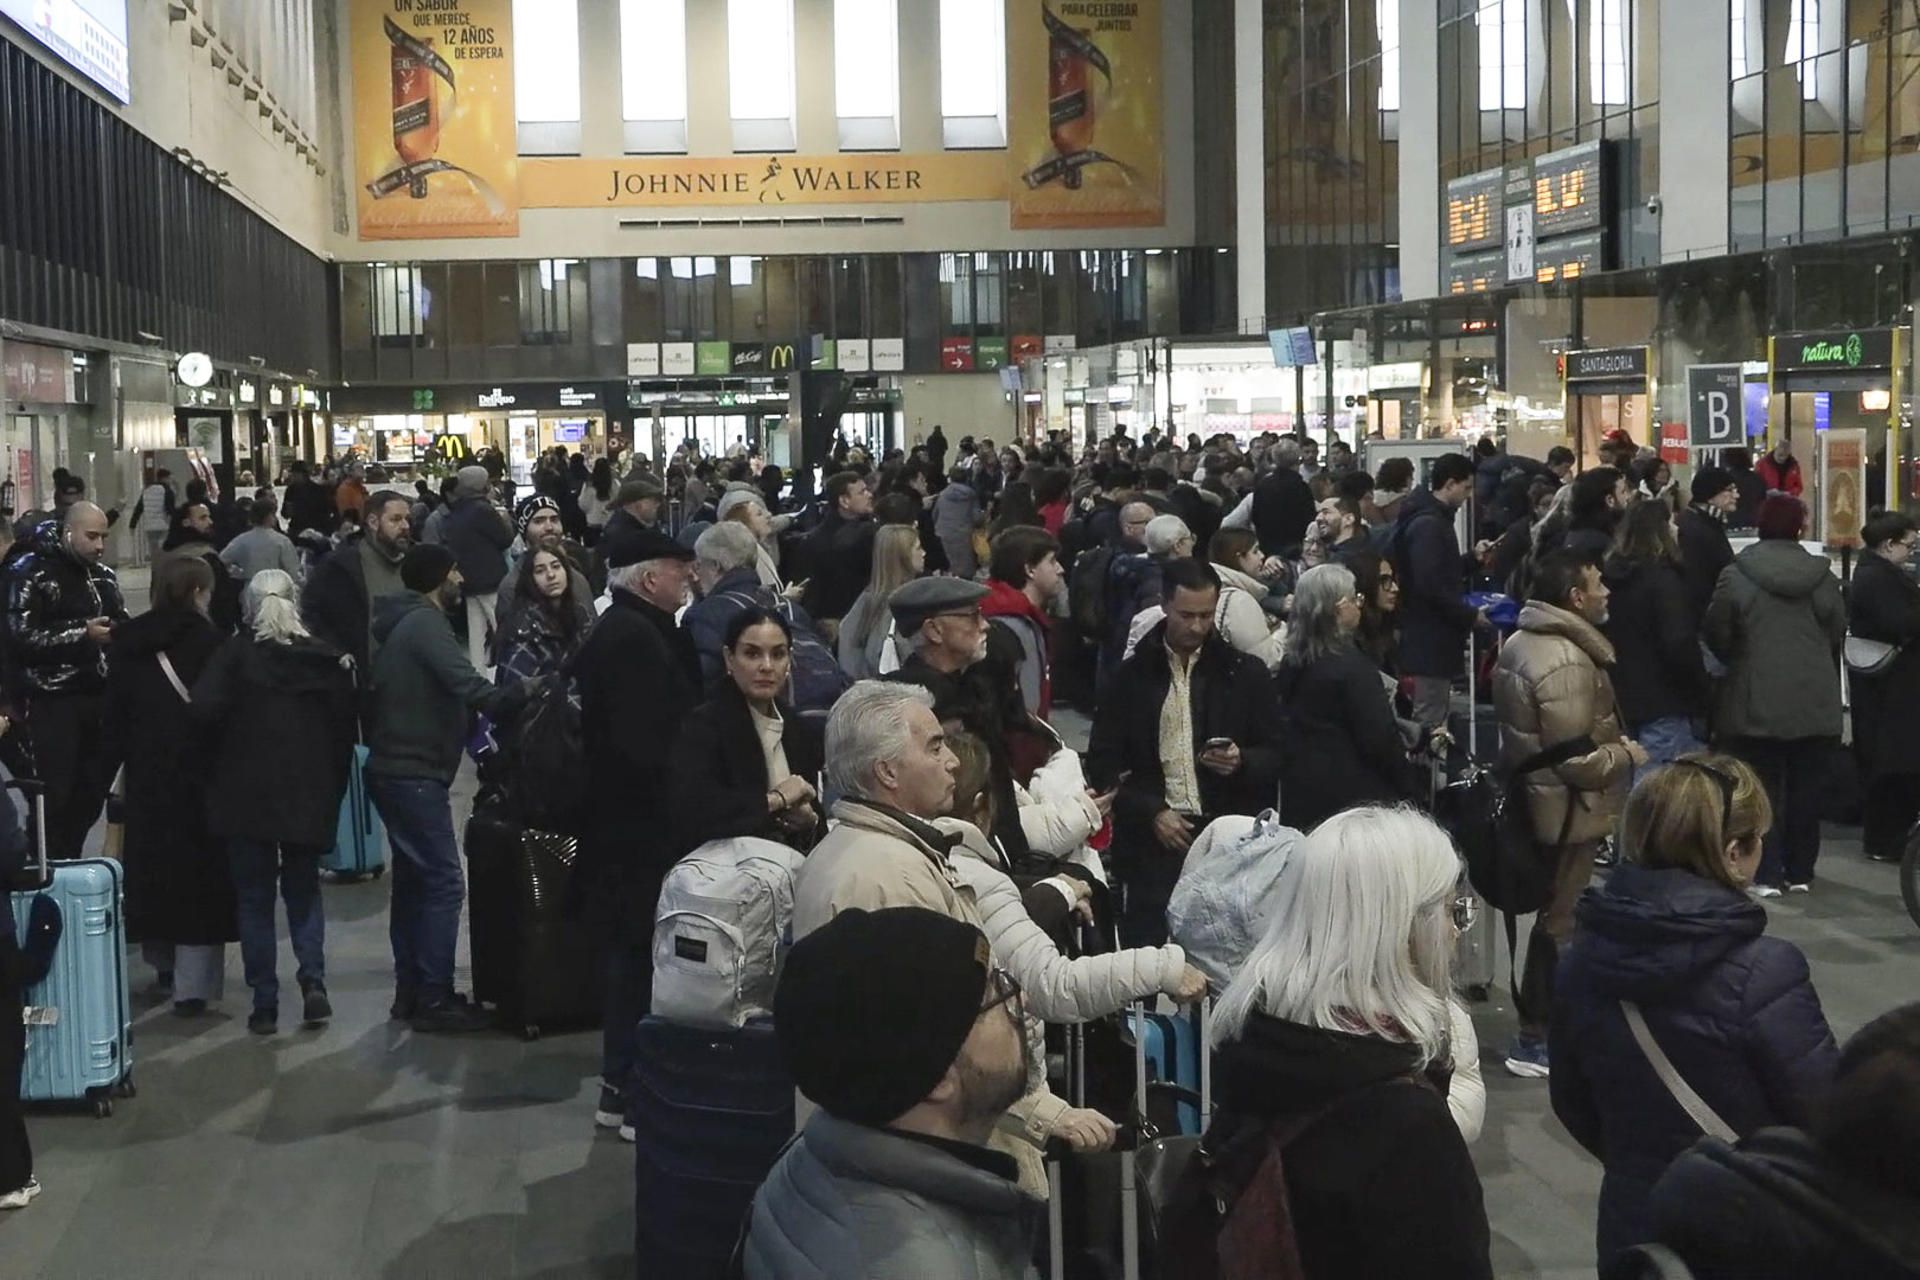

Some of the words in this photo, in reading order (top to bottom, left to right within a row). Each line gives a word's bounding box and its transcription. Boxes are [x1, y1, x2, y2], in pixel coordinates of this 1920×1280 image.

[413, 14, 431, 27] QUE
[434, 12, 471, 26] MERECE
[1086, 2, 1138, 17] CELEBRAR
[443, 28, 457, 46] 12
[460, 25, 495, 45] AÑOS
[454, 48, 467, 60] DE
[469, 46, 504, 59] ESPERA
[607, 170, 749, 201] JOHNNIE
[792, 166, 922, 191] WALKER
[1801, 341, 1845, 364] natura
[1580, 354, 1634, 374] SANTAGLORIA
[1707, 390, 1731, 440] B
